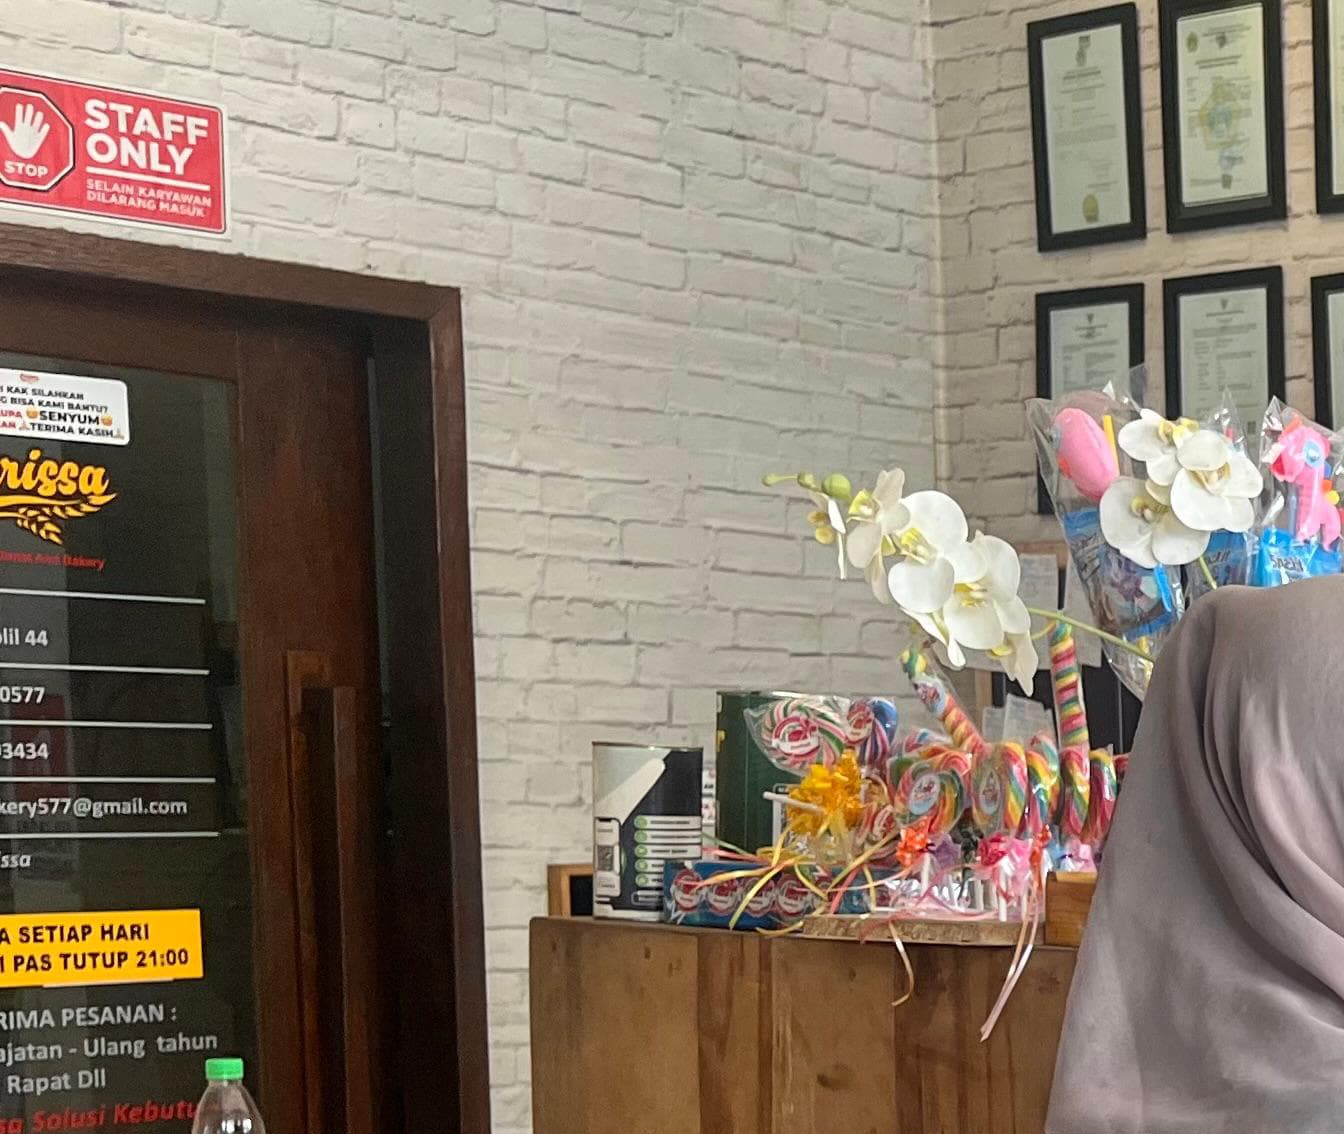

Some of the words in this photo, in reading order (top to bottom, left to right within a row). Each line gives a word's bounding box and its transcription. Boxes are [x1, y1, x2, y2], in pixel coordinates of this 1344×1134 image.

[84, 98, 209, 146] STAFF
[86, 132, 194, 176] ONLY
[4, 160, 49, 178] STOP
[86, 179, 134, 196] SELAIN
[138, 187, 212, 208] KARYAWAN
[86, 190, 156, 212] DILARANG
[158, 201, 206, 218] MASUK
[40, 411, 100, 425] SENYUM
[30, 423, 75, 434] TERIMA
[78, 427, 114, 438] KASIH
[24, 629, 49, 647] 44
[0, 686, 46, 704] 0577
[0, 850, 32, 869] ssa
[19, 924, 93, 944] SETIAP
[100, 923, 150, 942] HARI
[13, 953, 52, 972] PAS
[59, 951, 129, 970] TUTUP
[136, 948, 189, 968] 21:00
[61, 1003, 165, 1027] PESANAN
[83, 1037, 146, 1059] Ulang
[156, 1032, 219, 1053] tahun
[7, 1072, 72, 1096] Rapat
[31, 1109, 106, 1134] Solusi
